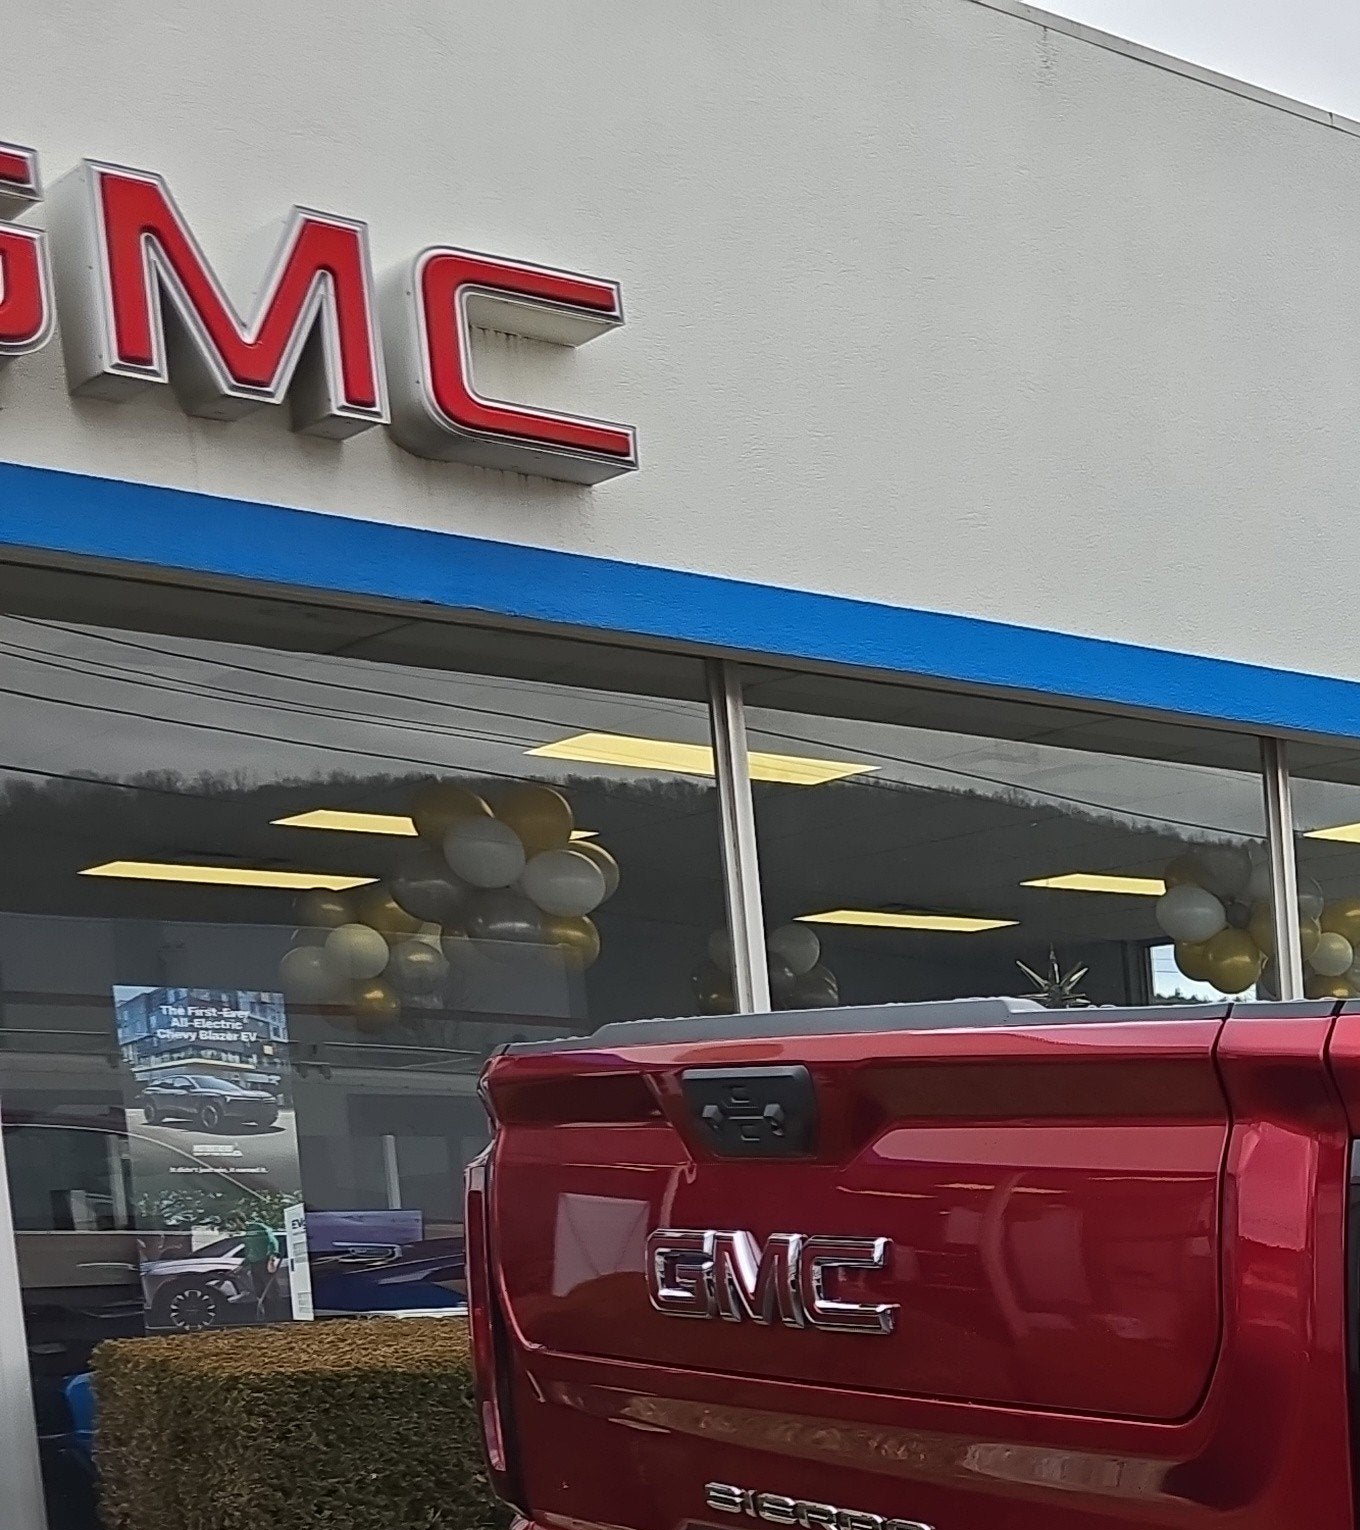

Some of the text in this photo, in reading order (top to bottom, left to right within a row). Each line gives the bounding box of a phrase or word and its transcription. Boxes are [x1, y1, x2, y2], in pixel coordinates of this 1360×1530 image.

[0, 142, 640, 486] MC
[159, 1005, 186, 1016] The
[170, 1017, 244, 1030] All-Electric
[156, 1028, 258, 1042] Chevy Blazer EV
[645, 1227, 901, 1336] GMC
